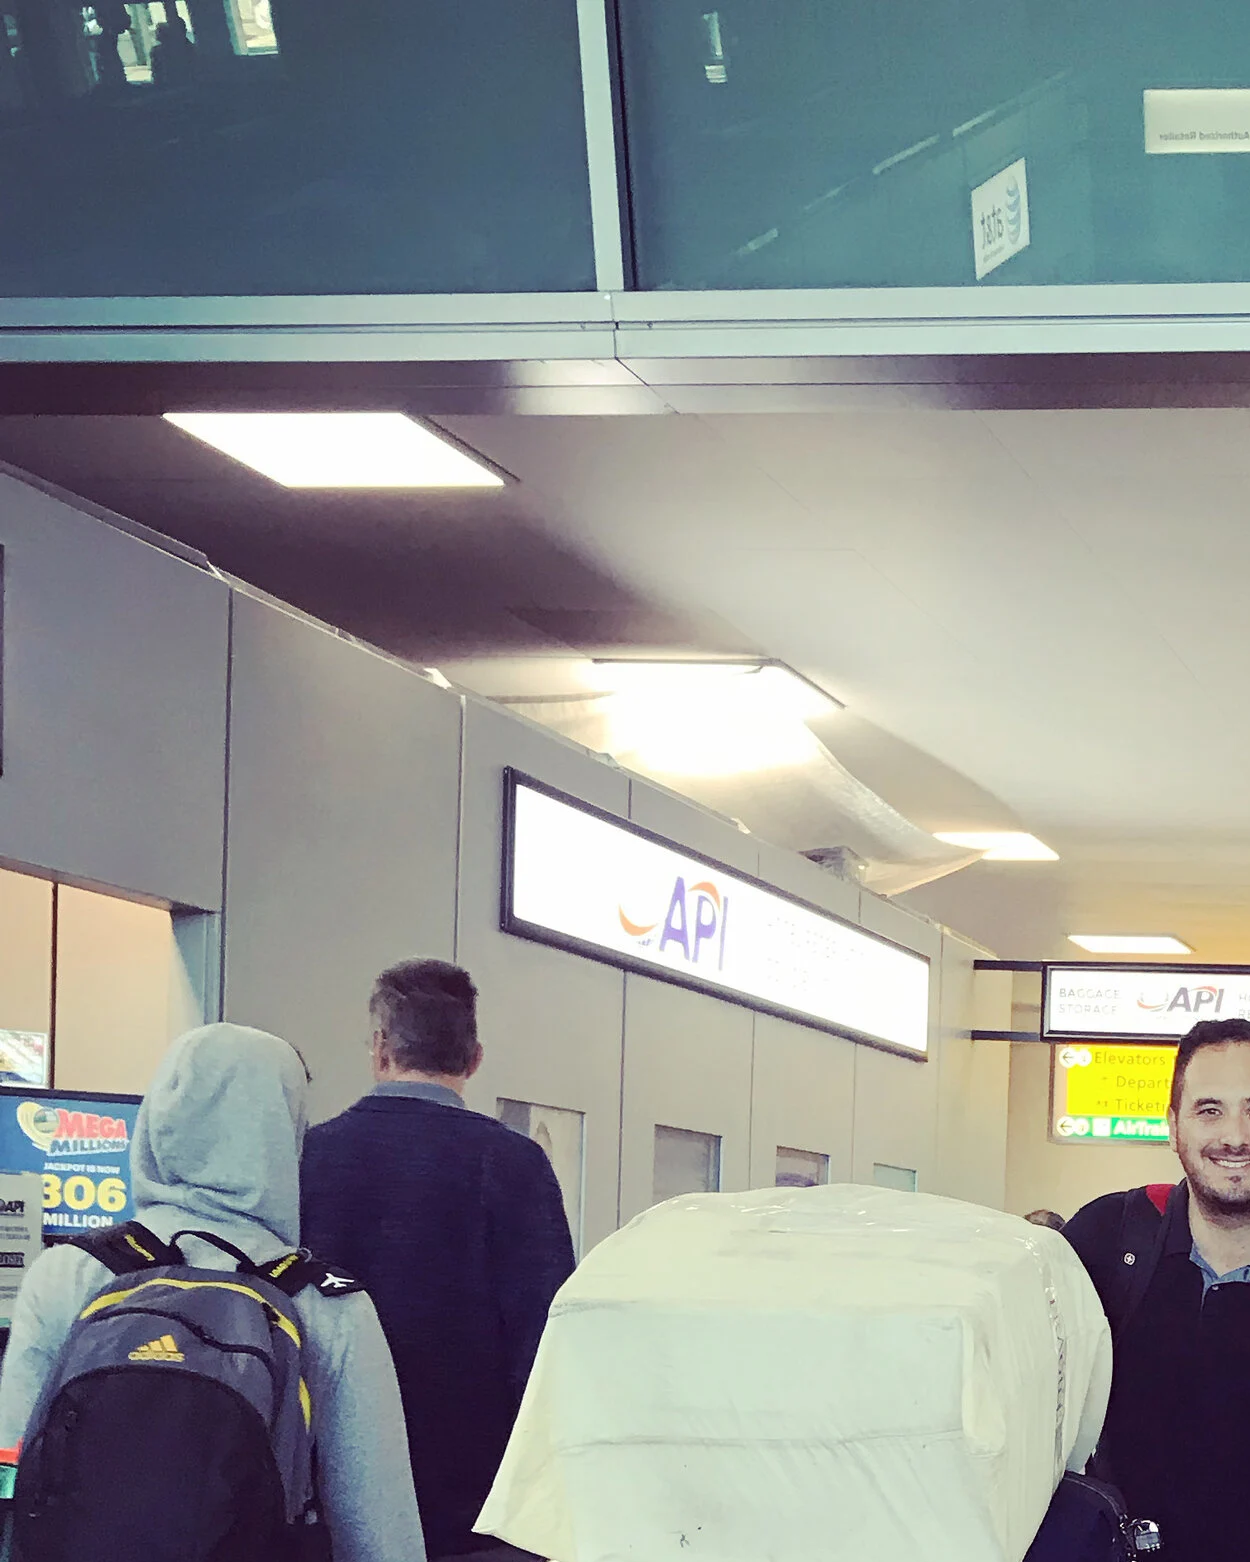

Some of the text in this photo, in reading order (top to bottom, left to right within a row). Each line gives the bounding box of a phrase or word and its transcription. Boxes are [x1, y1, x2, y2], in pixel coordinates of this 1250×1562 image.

[660, 876, 729, 971] API
[1166, 987, 1225, 1013] API
[1095, 1053, 1165, 1065] Elevators
[1116, 1076, 1170, 1090] Depart
[1115, 1098, 1165, 1111] Ticketi
[55, 1108, 127, 1139] MEGA
[1113, 1120, 1169, 1138] AirTrai
[44, 1162, 85, 1172] JACKPOT
[42, 1212, 113, 1229] MILLION
